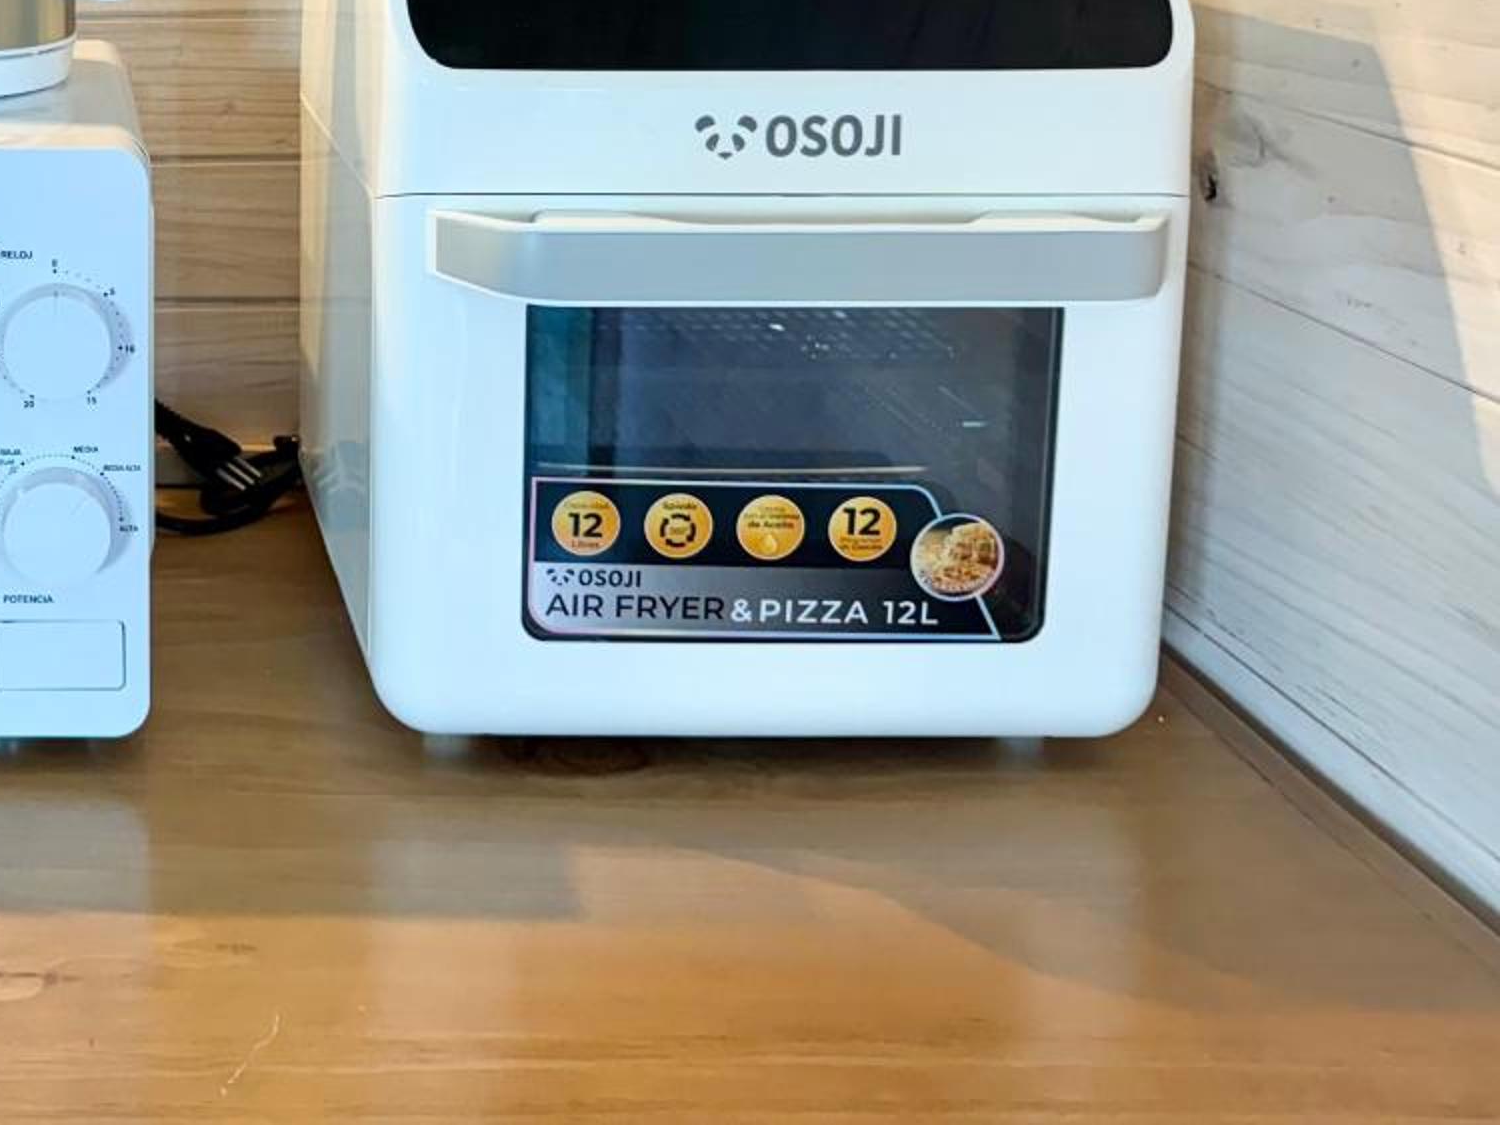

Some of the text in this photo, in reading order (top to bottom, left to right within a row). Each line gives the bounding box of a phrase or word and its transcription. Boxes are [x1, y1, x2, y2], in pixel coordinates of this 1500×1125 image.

[765, 114, 902, 157] OSOJI
[1, 250, 33, 260] RELOJ
[568, 512, 603, 537] 12
[843, 507, 881, 535] 12
[578, 568, 641, 588] OSOJI
[3, 594, 54, 604] POTENCIA
[546, 593, 604, 618] AIR
[615, 595, 725, 620] FRYER
[759, 599, 869, 624] PIZZA
[883, 601, 939, 625] 12L
